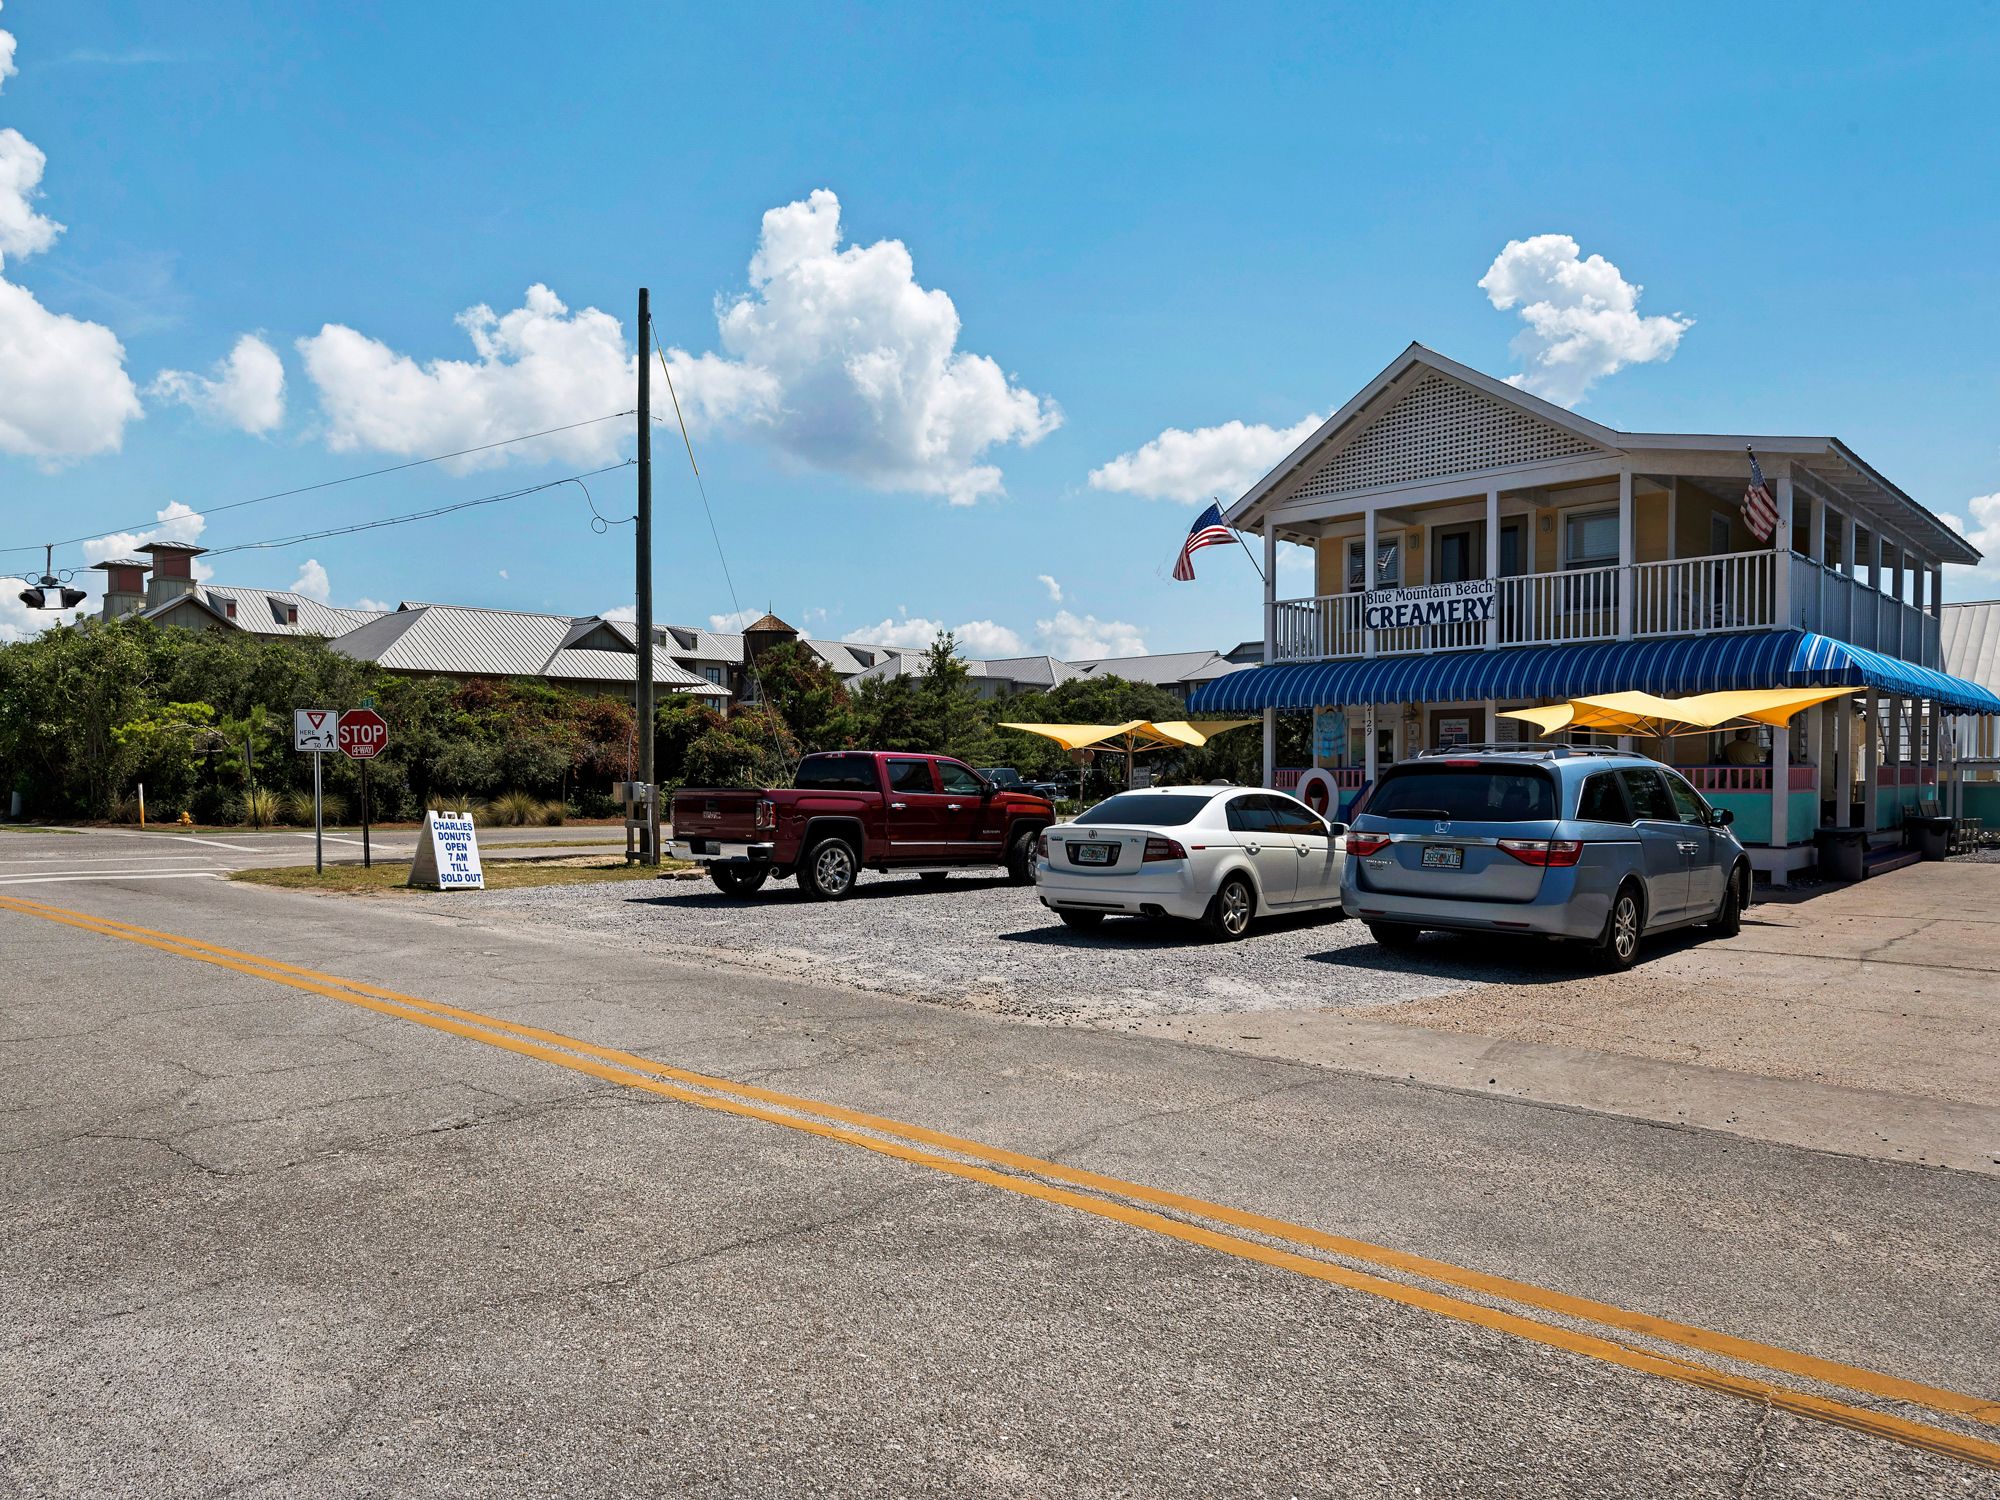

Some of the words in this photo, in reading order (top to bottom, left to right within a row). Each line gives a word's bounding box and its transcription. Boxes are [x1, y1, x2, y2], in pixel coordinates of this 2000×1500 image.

[1366, 591, 1392, 605] Blue
[1396, 585, 1452, 601] Mountain
[1456, 580, 1492, 594] Beach
[1366, 596, 1493, 629] CREAMERY
[339, 725, 384, 744] STOP
[352, 746, 373, 755] 4-WAY
[433, 821, 473, 831] CHARLIES
[438, 832, 471, 841] DONUTS
[445, 842, 467, 851] OPEN
[448, 853, 454, 861] 7
[455, 853, 468, 862] AM
[451, 863, 469, 872] TILL
[441, 874, 463, 883] SOLD
[464, 874, 481, 882] OUT
